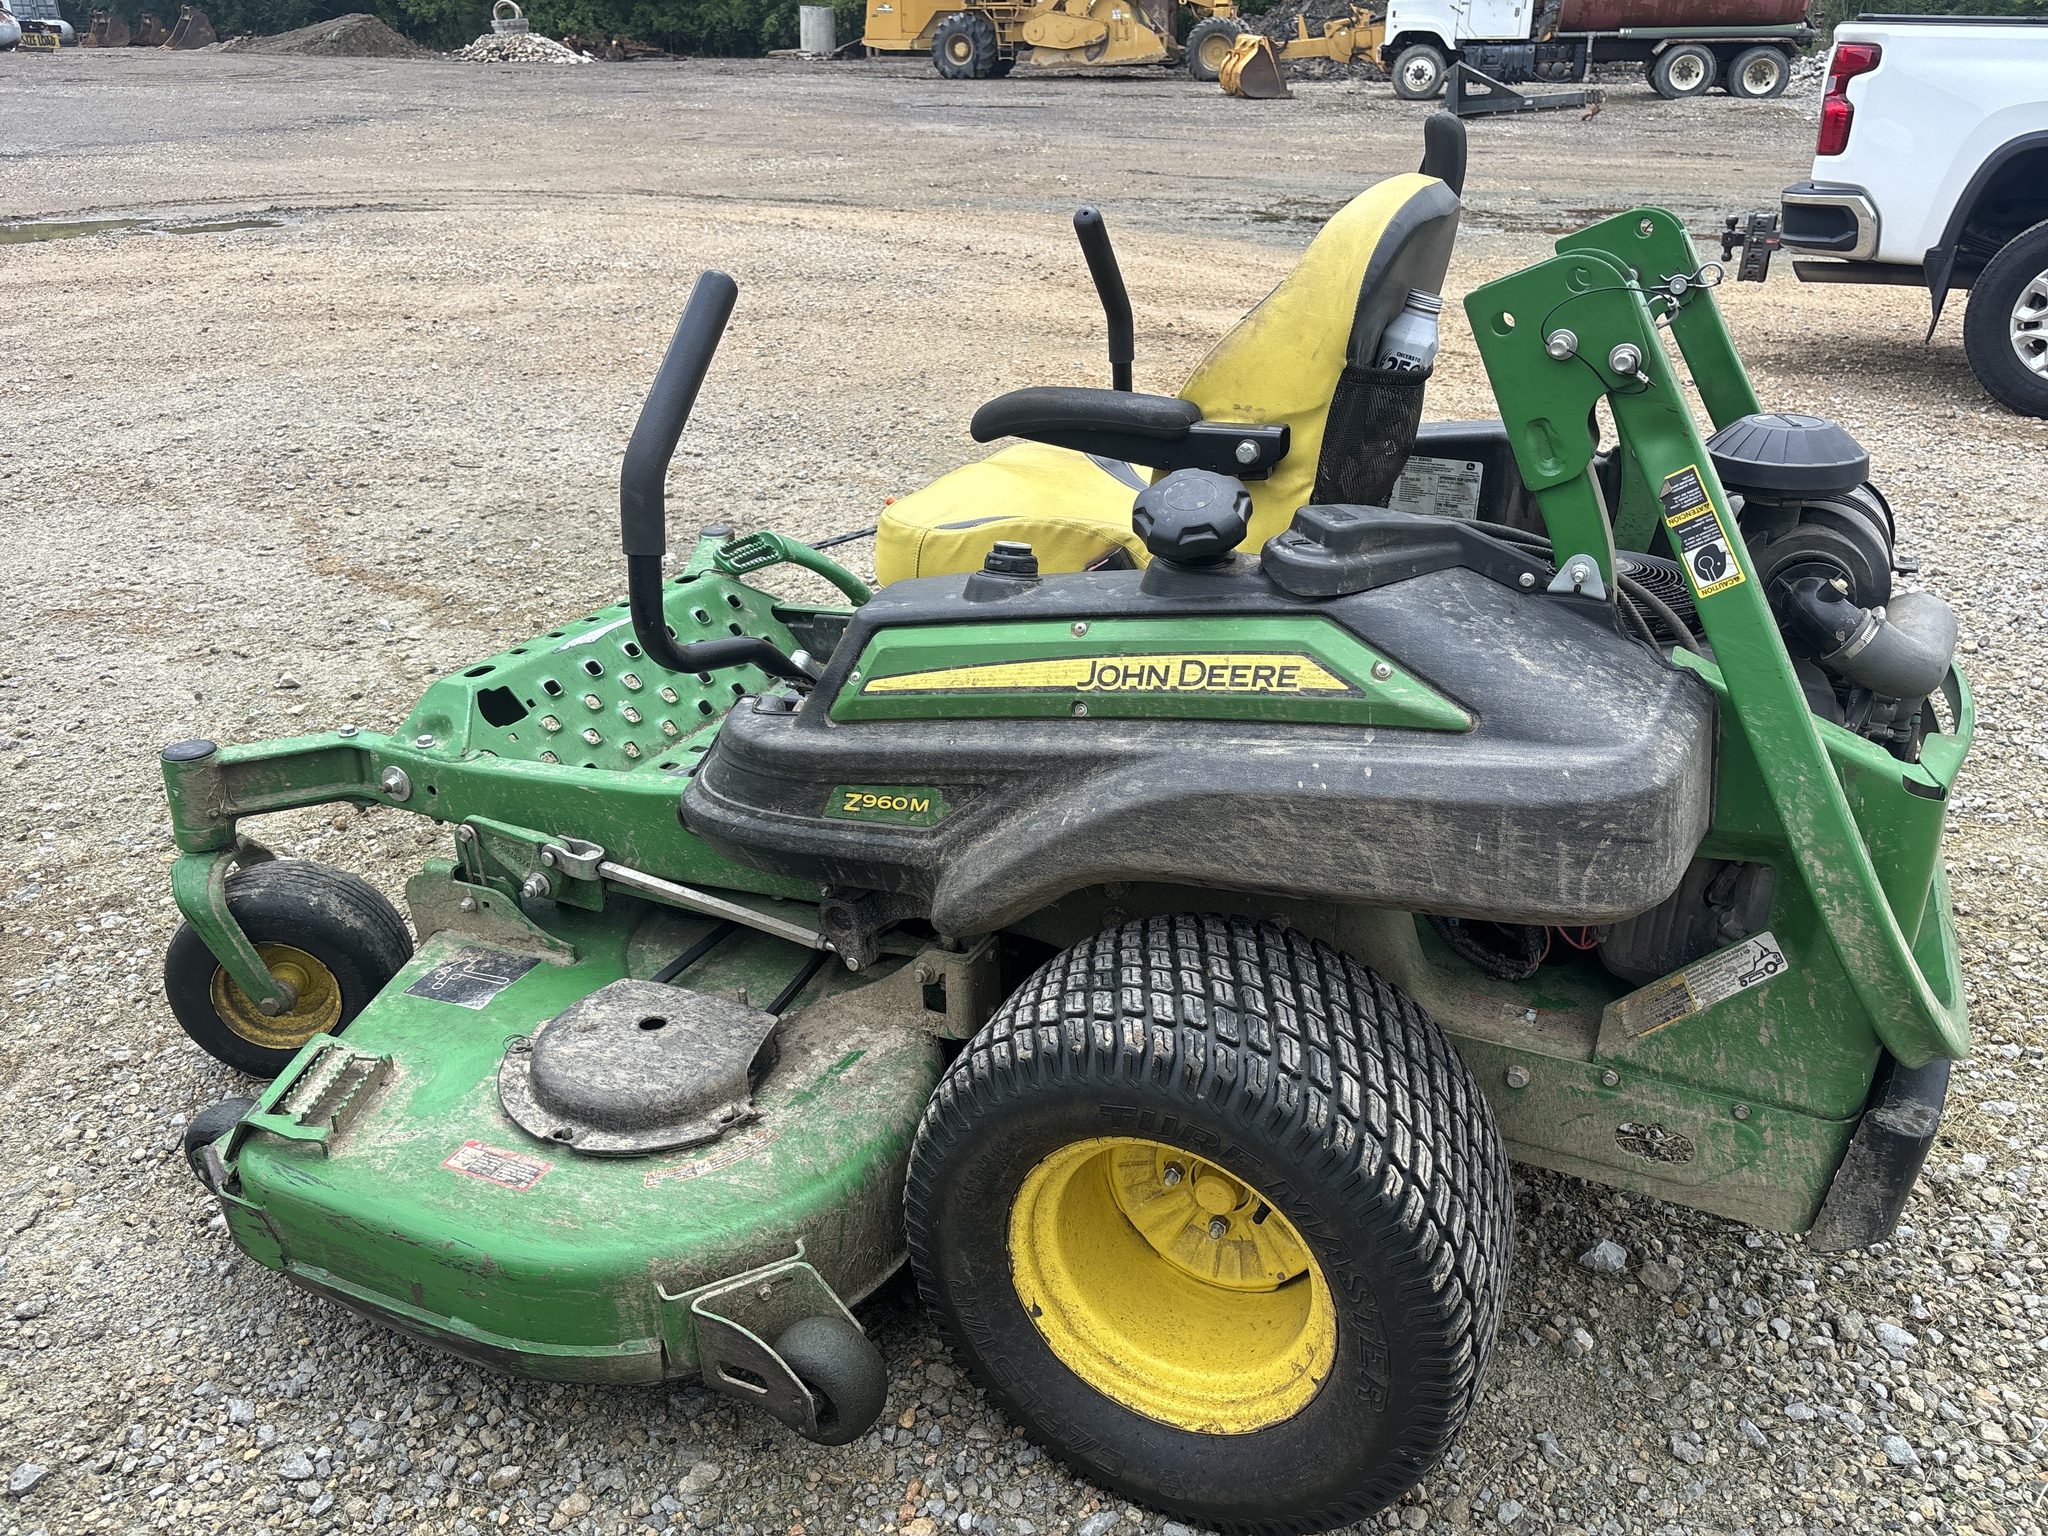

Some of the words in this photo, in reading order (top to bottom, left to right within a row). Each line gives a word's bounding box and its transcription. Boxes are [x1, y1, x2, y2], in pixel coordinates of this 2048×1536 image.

[40, 35, 56, 47] LOAD
[1701, 577, 1735, 596] CAUTION
[1077, 660, 1171, 687] JOHN
[1178, 659, 1301, 688] DEERE
[842, 791, 931, 814] Z960M
